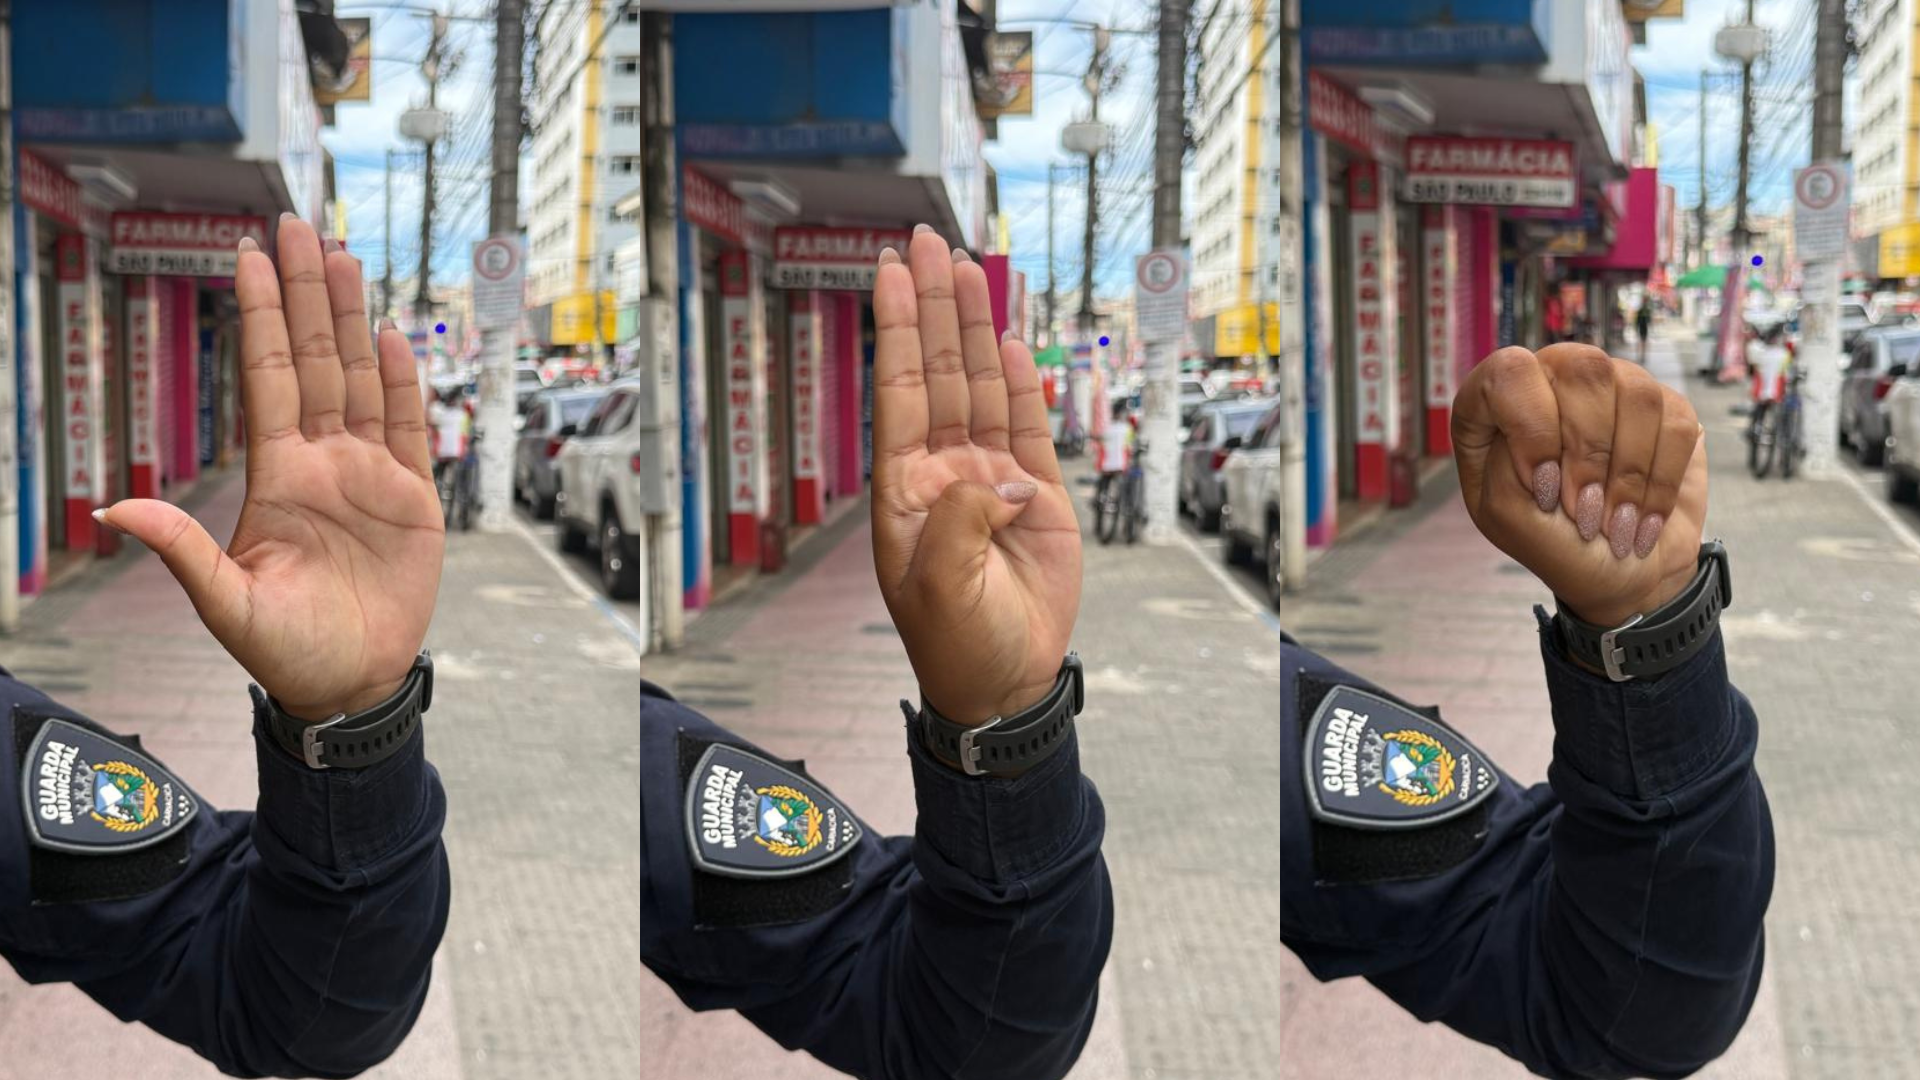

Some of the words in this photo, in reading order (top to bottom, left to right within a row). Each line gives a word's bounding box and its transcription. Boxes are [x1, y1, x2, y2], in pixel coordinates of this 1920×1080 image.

[1411, 142, 1571, 173] FARMÁCIA
[1412, 180, 1447, 200] SÃO
[1455, 182, 1517, 202] PAULO
[118, 252, 149, 271] SÃO
[155, 253, 214, 273] PAULO
[39, 741, 66, 820] GUARDA
[56, 746, 80, 825] MUNICIPAL
[1322, 707, 1354, 792] GUARDA
[1340, 713, 1369, 796] MUNICIPAL
[702, 764, 730, 844] GUARDA
[720, 770, 743, 848] MUNICIPAL
